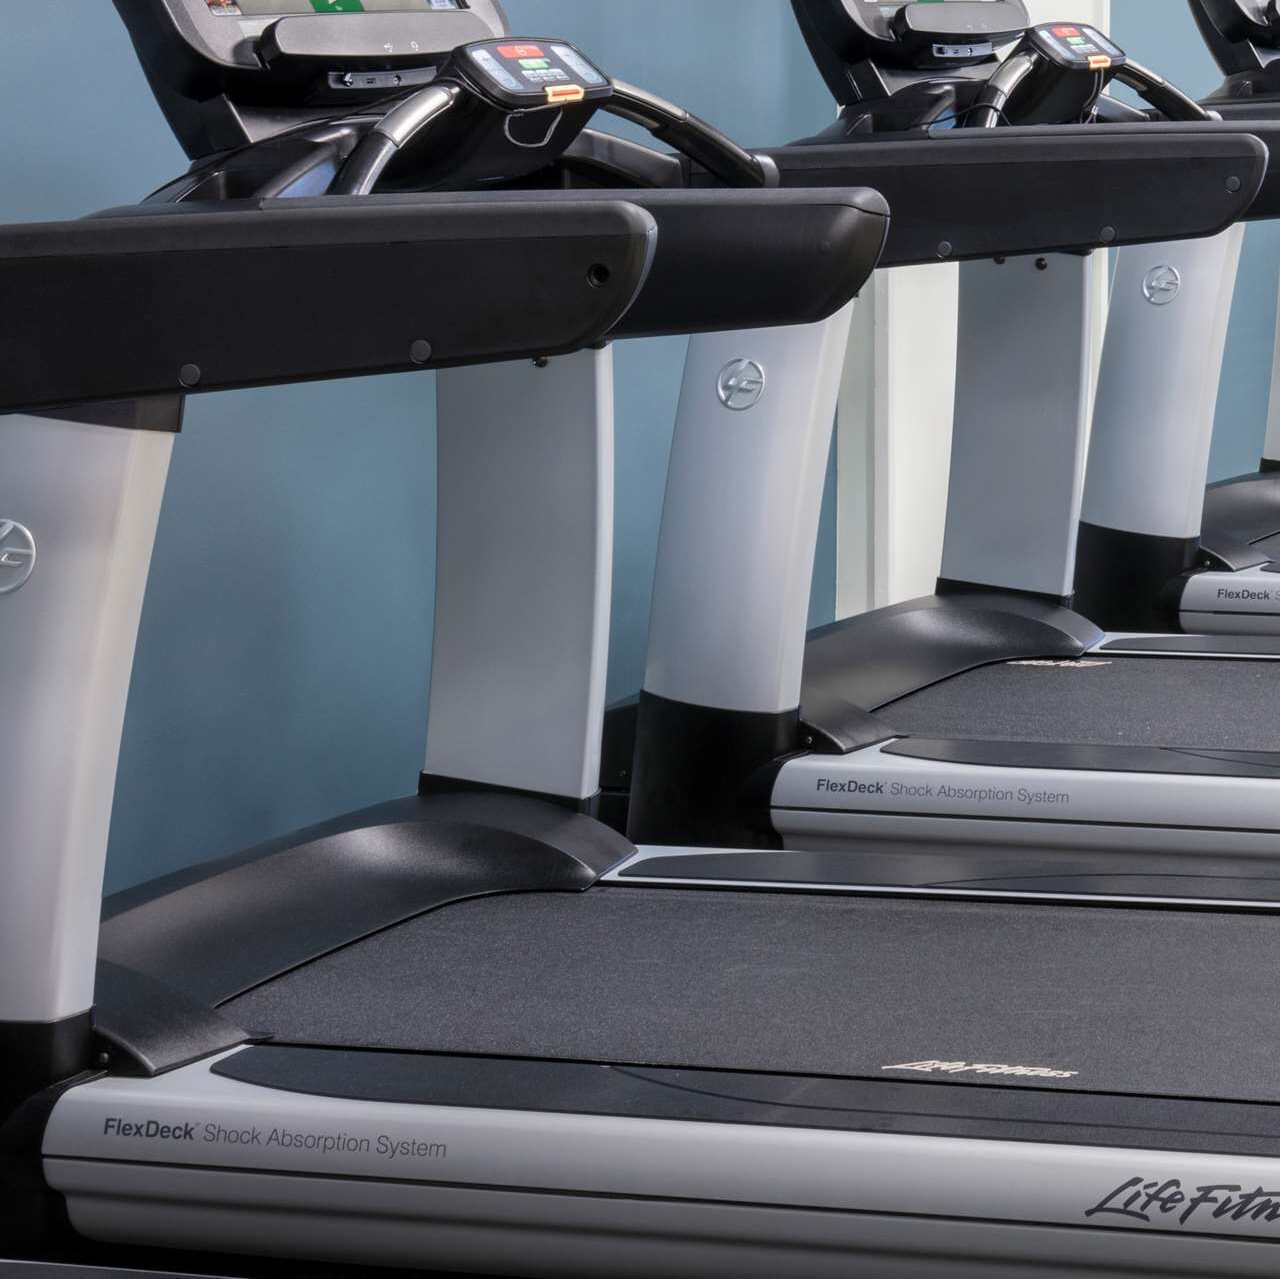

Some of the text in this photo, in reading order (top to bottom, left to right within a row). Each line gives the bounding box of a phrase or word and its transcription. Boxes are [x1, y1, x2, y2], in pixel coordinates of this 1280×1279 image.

[1216, 587, 1271, 601] FlexDeck
[816, 778, 1070, 807] FlexDeck Shock Absorption System
[103, 1117, 447, 1159] FlexDeck Shock Absorption System
[1084, 1175, 1185, 1223] Life
